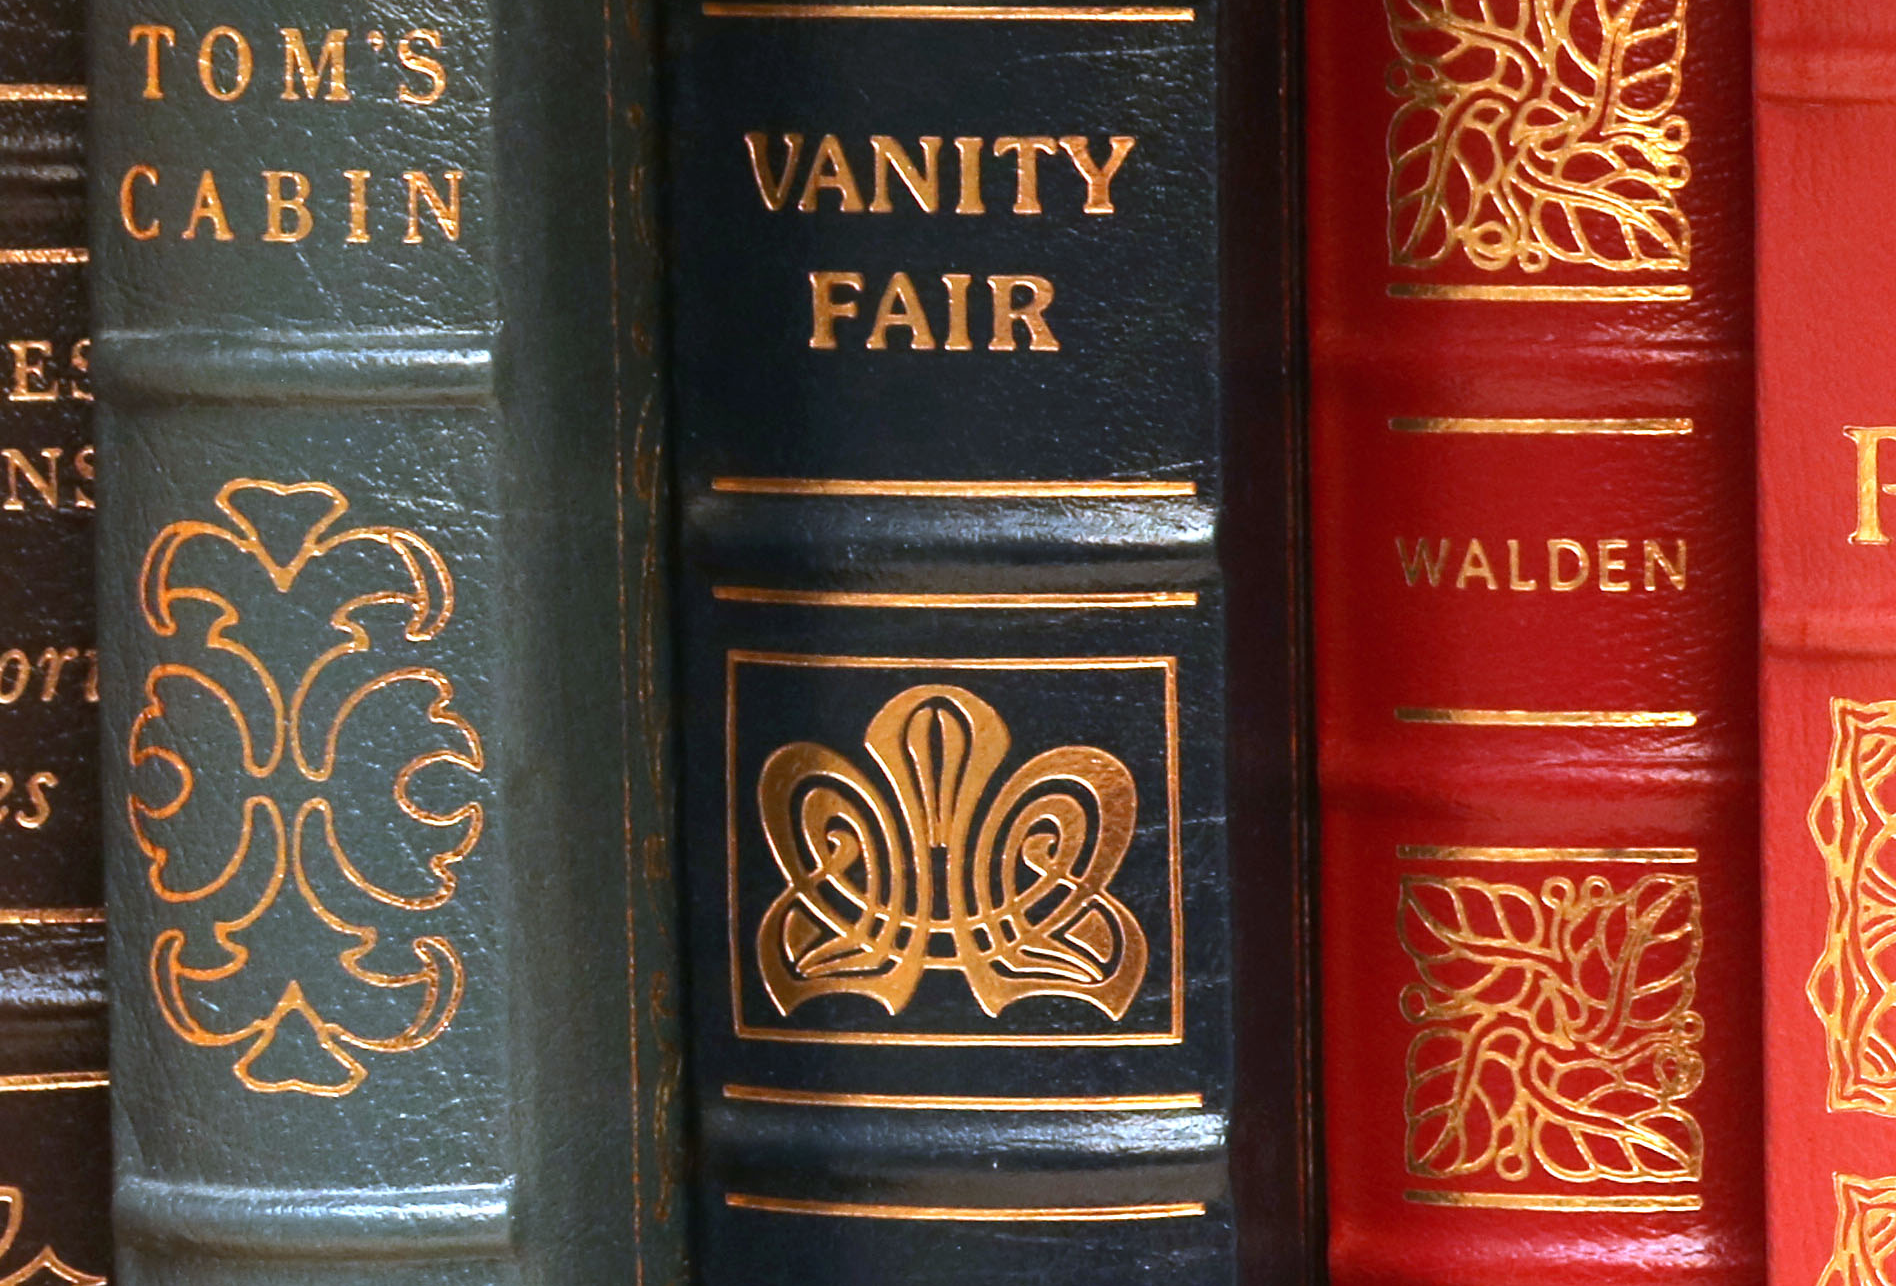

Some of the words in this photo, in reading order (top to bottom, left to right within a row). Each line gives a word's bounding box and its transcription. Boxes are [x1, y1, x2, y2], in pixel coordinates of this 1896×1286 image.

[129, 24, 448, 104] TOM'S
[118, 164, 462, 245] CABIN
[744, 133, 1136, 215] VANITY
[808, 271, 1061, 352] FAIR
[1394, 536, 1688, 592] WALDEN
